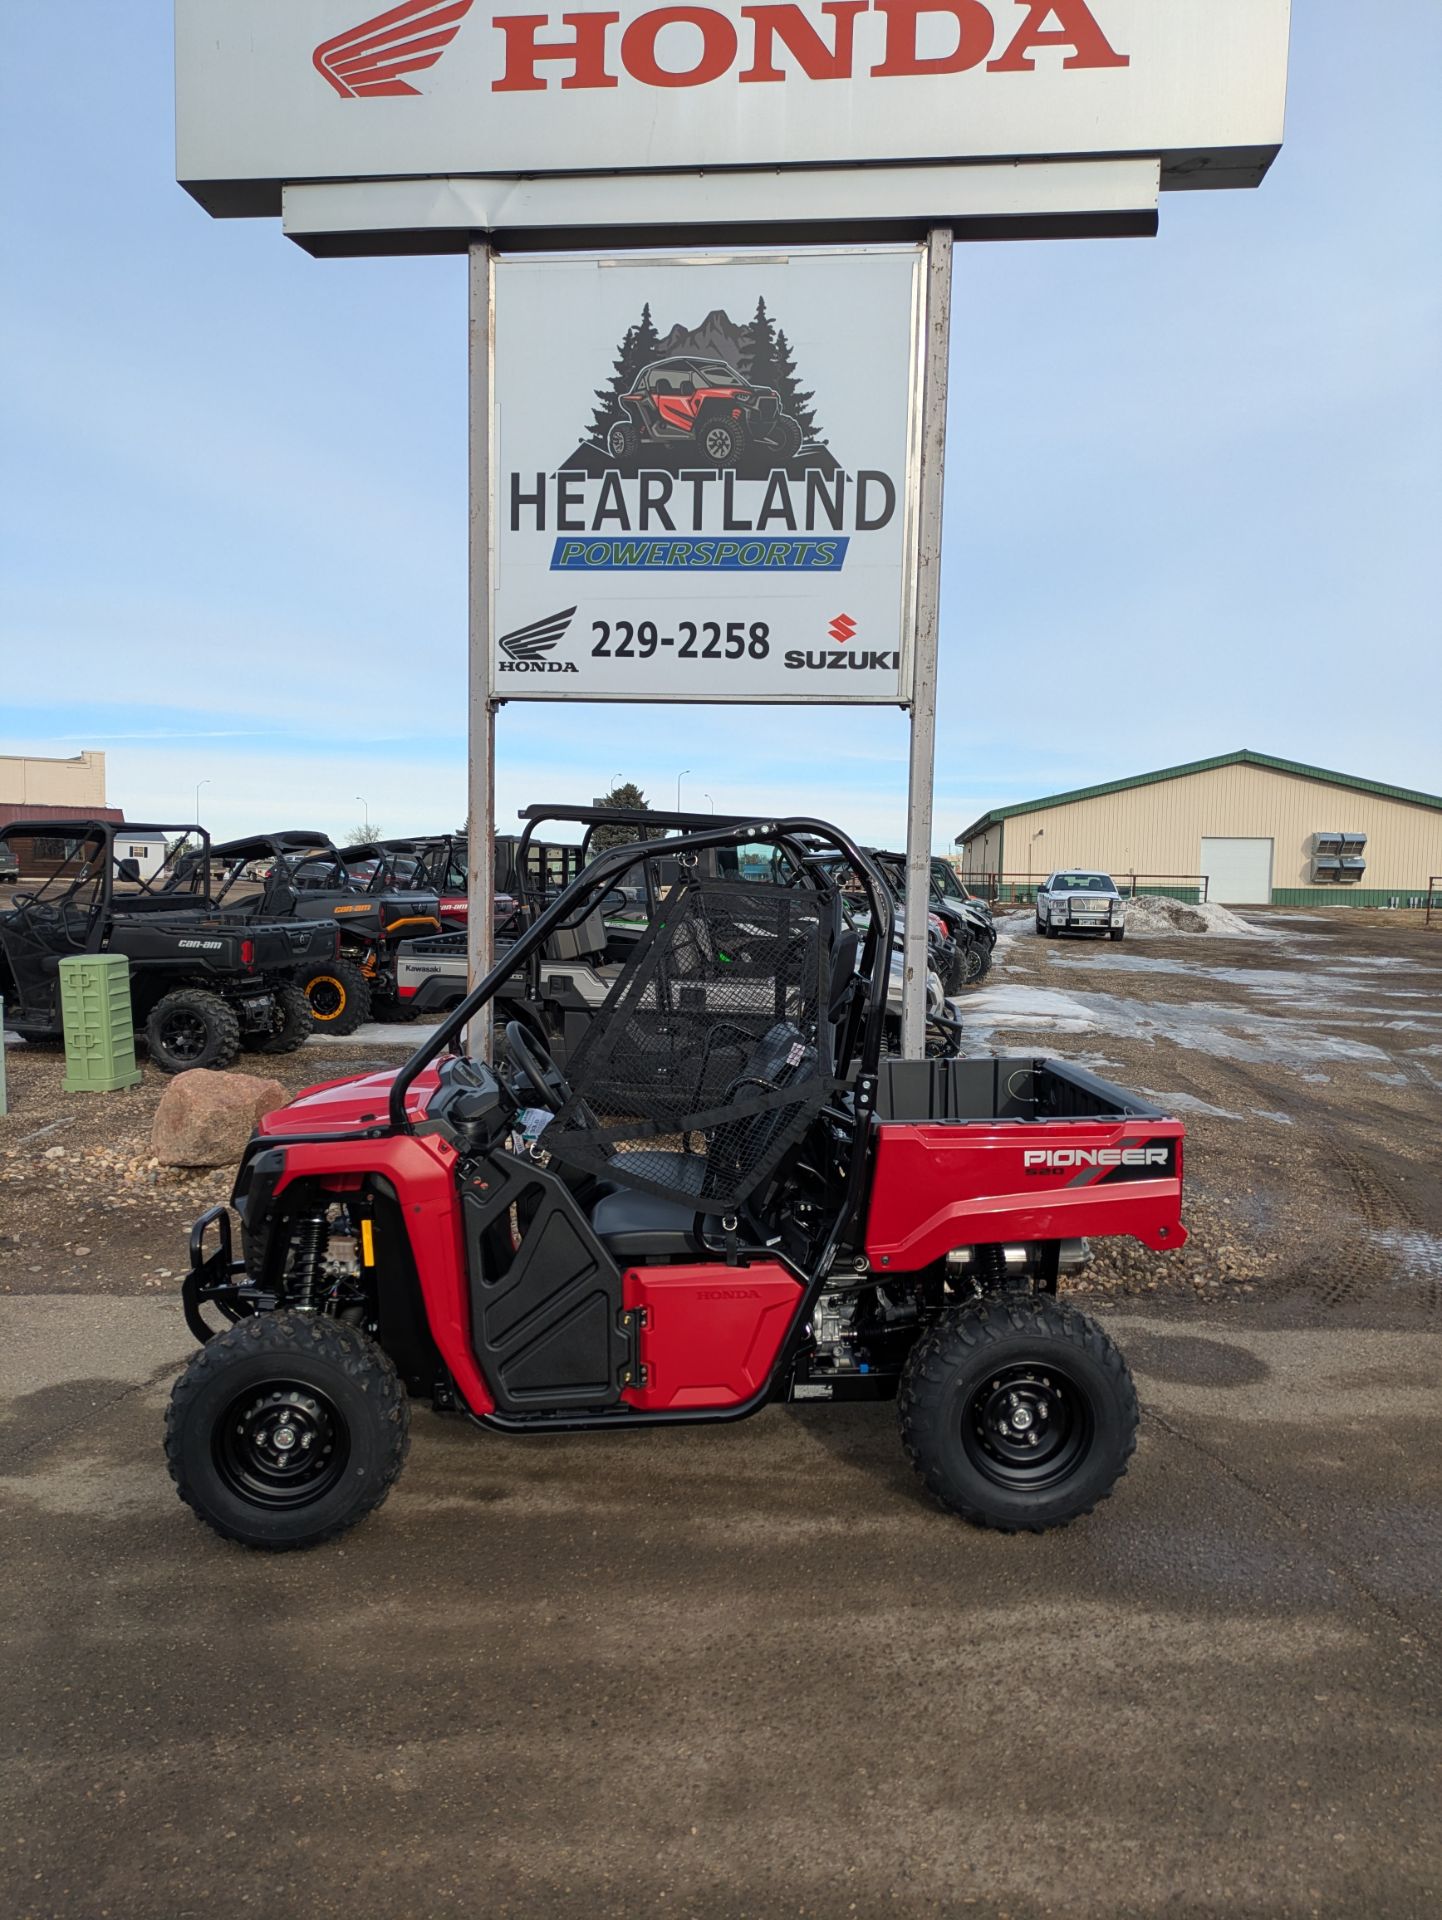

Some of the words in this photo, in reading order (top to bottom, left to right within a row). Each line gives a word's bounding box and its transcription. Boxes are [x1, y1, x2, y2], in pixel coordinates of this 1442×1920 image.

[491, 0, 1130, 92] HONDA
[510, 469, 897, 532] HEARTLAND
[559, 541, 838, 566] POWERSPORTS
[590, 620, 771, 660] 229-2258
[498, 661, 580, 674] HONDA
[784, 650, 900, 670] SUZUKI
[178, 939, 223, 950] can-am
[405, 964, 442, 973] Kawasaki
[1024, 1148, 1168, 1167] PIONEER
[1025, 1167, 1064, 1175] 520
[697, 1290, 761, 1300] HONDA
